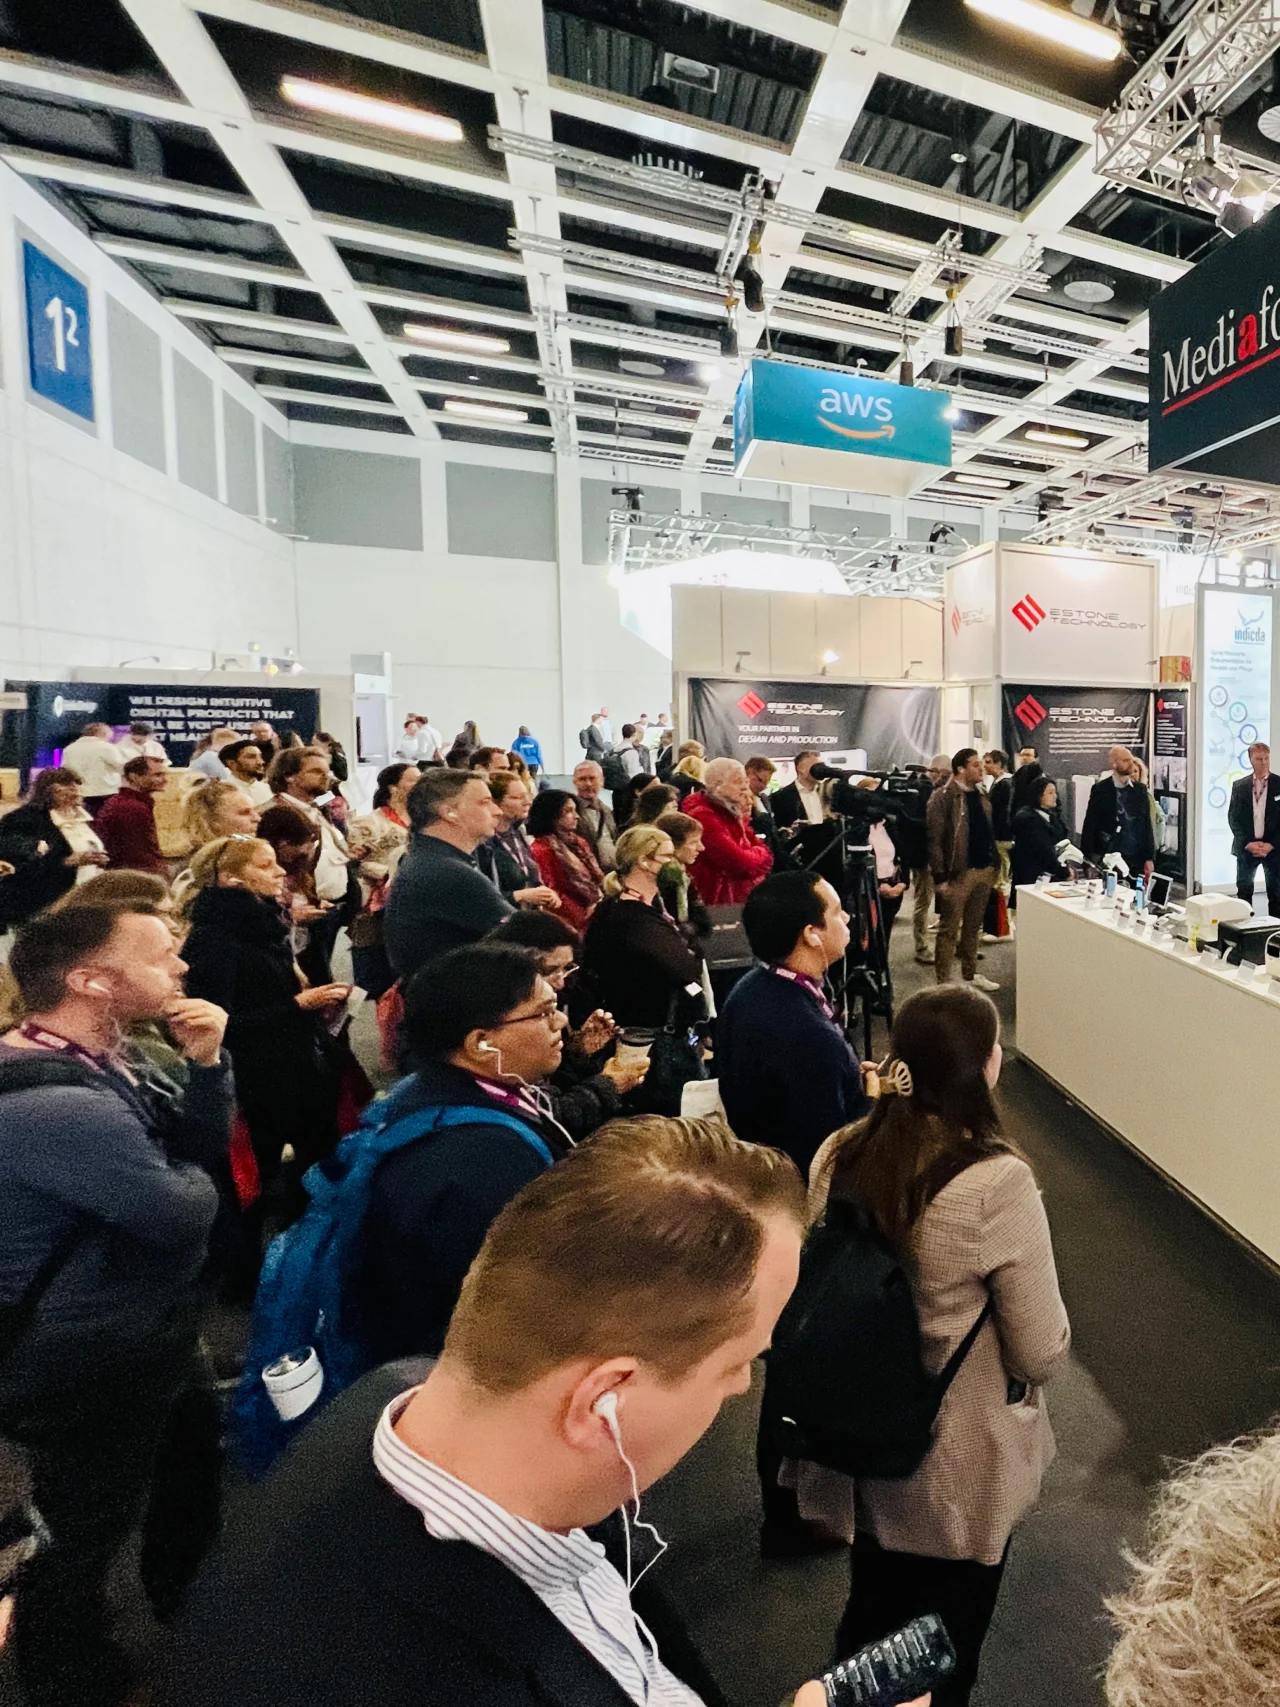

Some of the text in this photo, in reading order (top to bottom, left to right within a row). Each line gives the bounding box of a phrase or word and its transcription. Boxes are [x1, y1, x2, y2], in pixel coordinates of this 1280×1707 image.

[820, 388, 893, 422] aws
[1049, 608, 1120, 621] ESTONE
[1051, 617, 1147, 630] TECHNOLOGY
[1234, 626, 1266, 642] indicda
[209, 697, 273, 708] INTUITIVE
[767, 702, 823, 710] ESTONE
[130, 708, 295, 720] DIGITAL PRODUCTS THAT
[768, 709, 845, 717] TECHNOLOGY
[1049, 707, 1116, 716] ESTONE
[760, 725, 791, 733] PARTNER
[770, 735, 786, 744] AND
[786, 735, 838, 744] PRODUCTION
